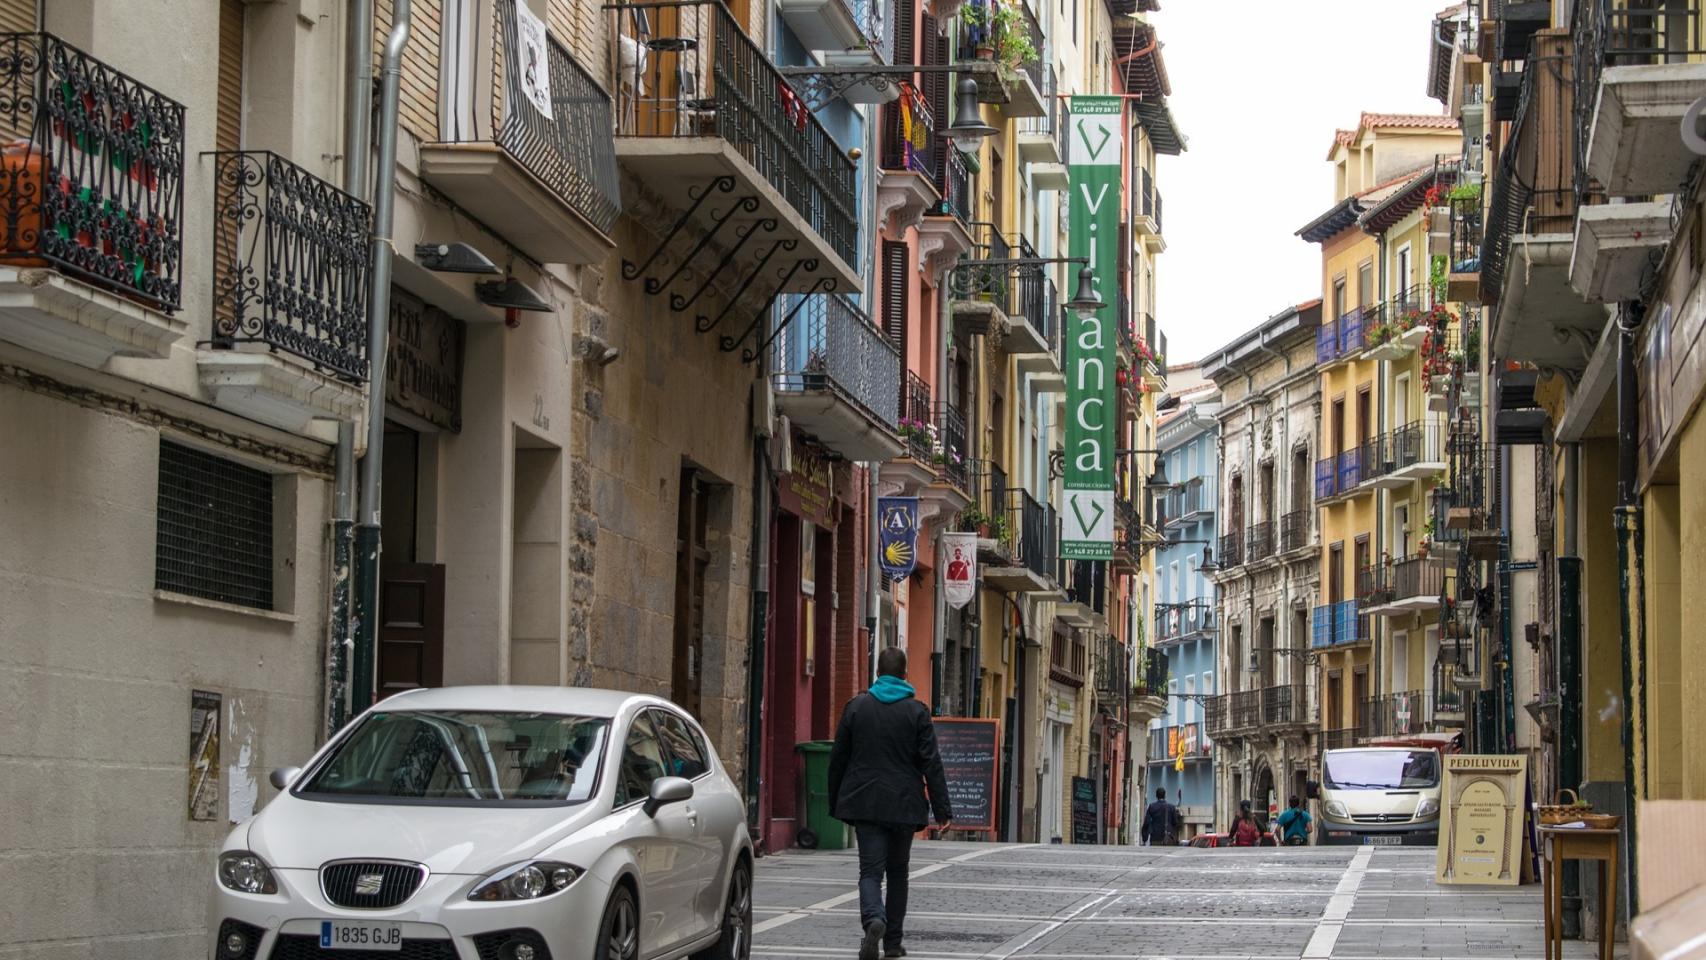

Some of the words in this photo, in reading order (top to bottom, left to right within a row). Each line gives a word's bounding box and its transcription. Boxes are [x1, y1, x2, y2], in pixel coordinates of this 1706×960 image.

[890, 511, 905, 528] A
[1449, 758, 1520, 768] PEDILUVIUM
[335, 927, 368, 943] 1835
[372, 927, 401, 945] GJB
